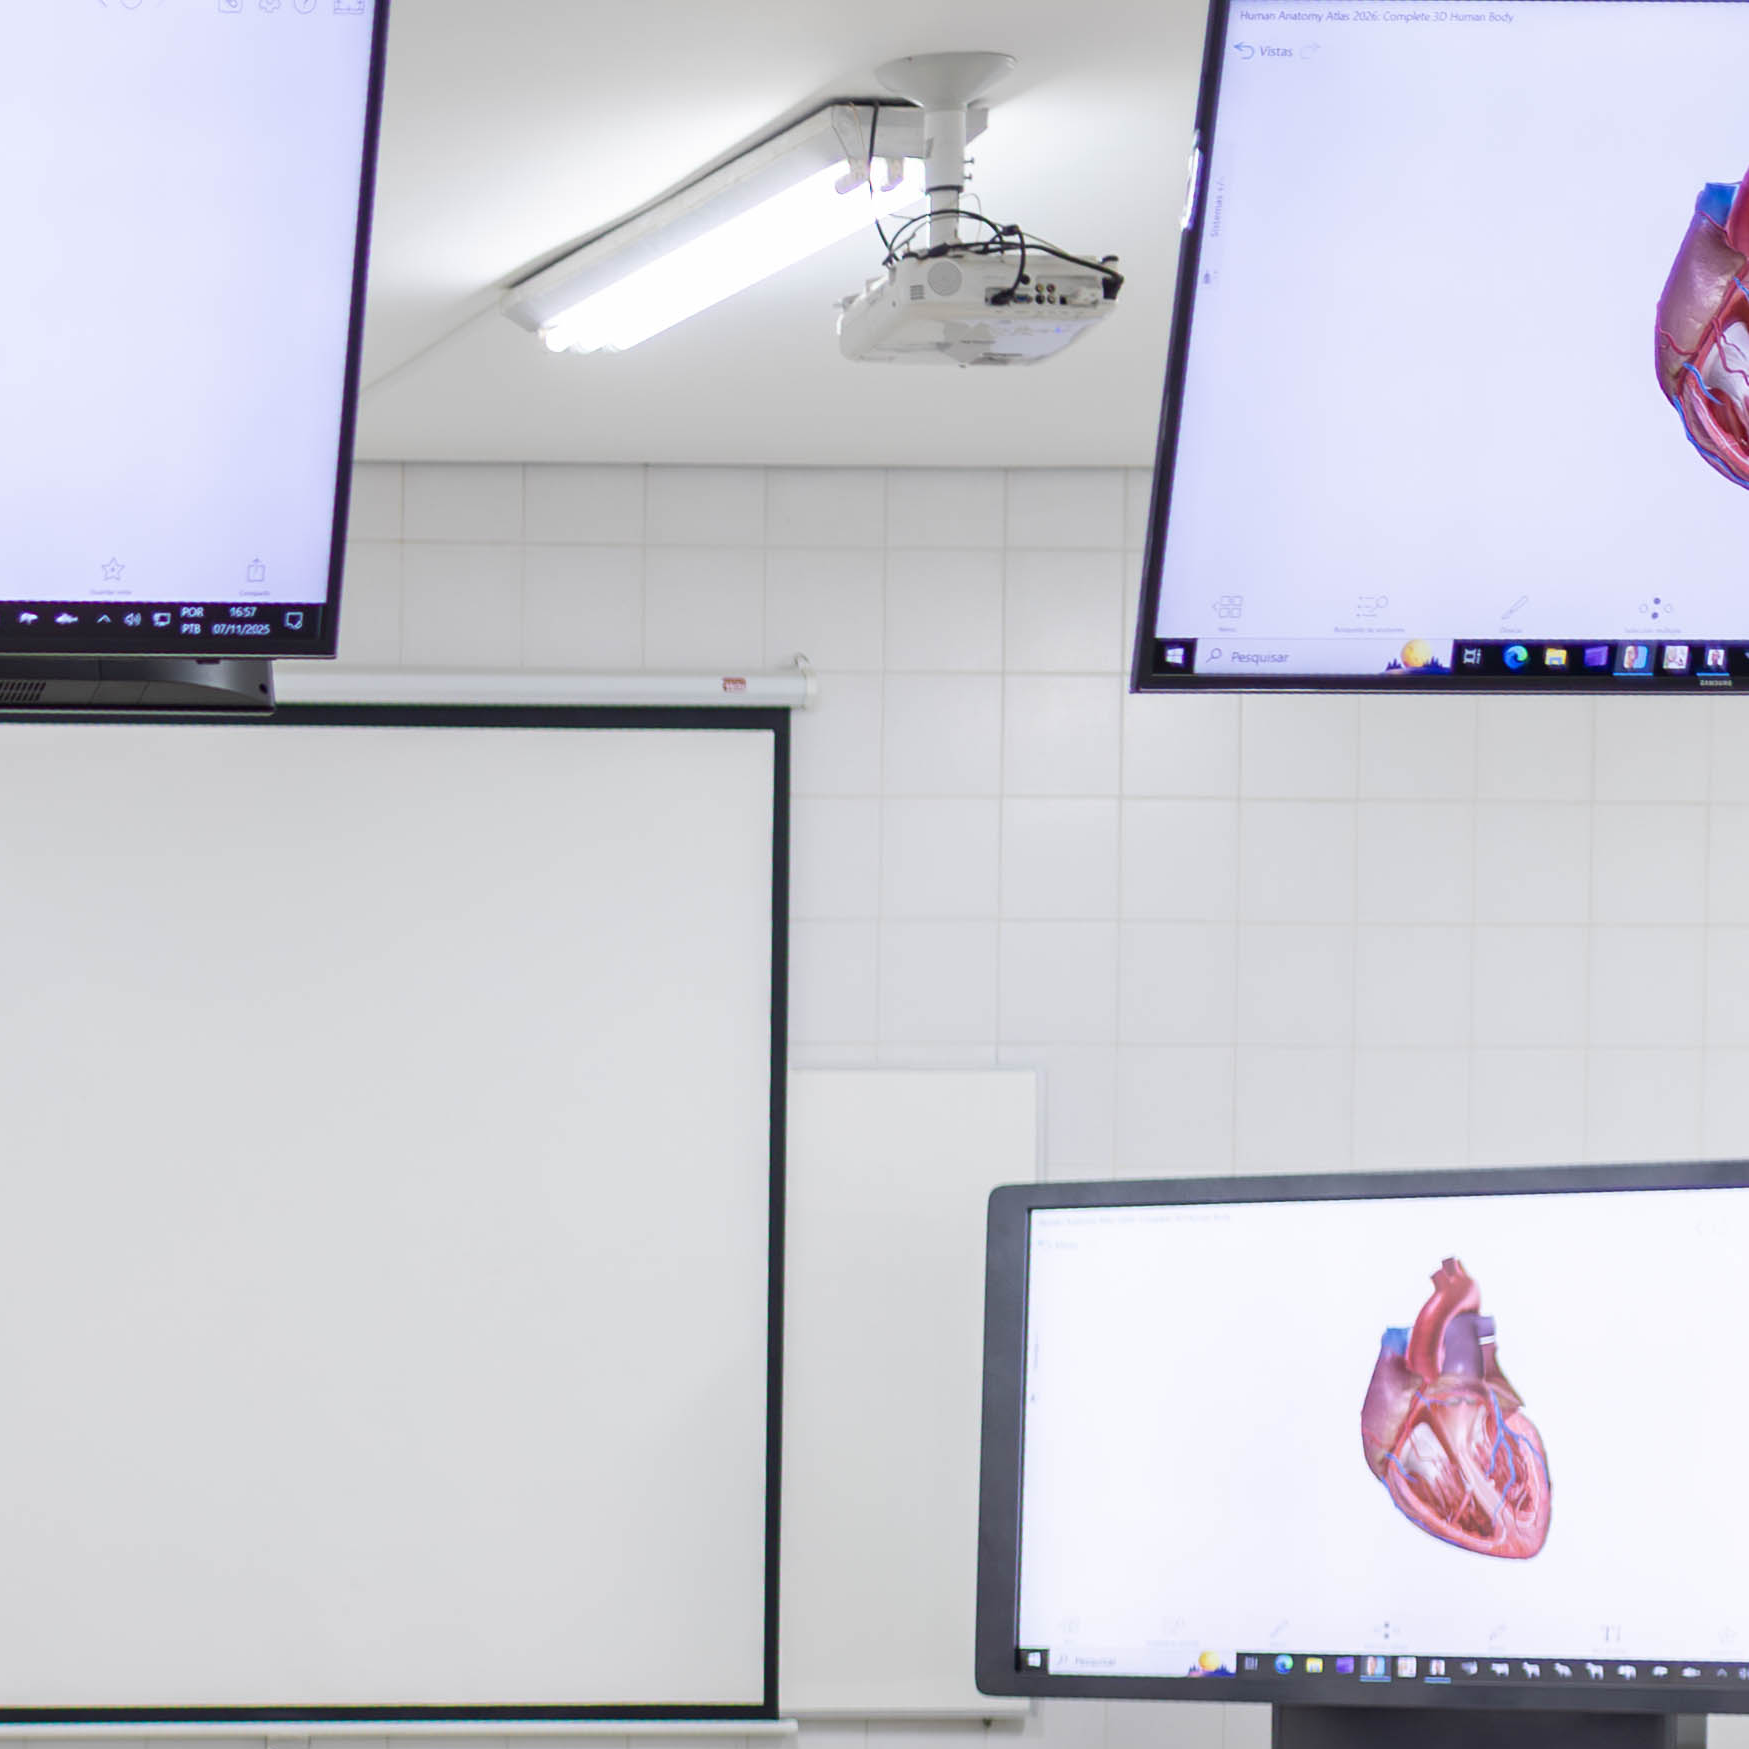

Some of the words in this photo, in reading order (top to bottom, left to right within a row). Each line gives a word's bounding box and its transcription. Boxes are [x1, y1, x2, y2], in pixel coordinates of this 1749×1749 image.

[1240, 10, 1276, 22] Human
[1278, 11, 1323, 23] Anatomy
[1326, 11, 1350, 22] Atlas
[1383, 11, 1430, 24] Complete
[1433, 11, 1448, 22] 3D
[1451, 11, 1486, 22] Human
[1489, 12, 1513, 24] Body
[1259, 45, 1293, 58] Vistas
[181, 607, 204, 617] POR
[229, 607, 257, 617] 16:57
[181, 624, 201, 634] PTB
[212, 624, 270, 635] 07/11/2025
[1231, 651, 1290, 664] Pesquisar
